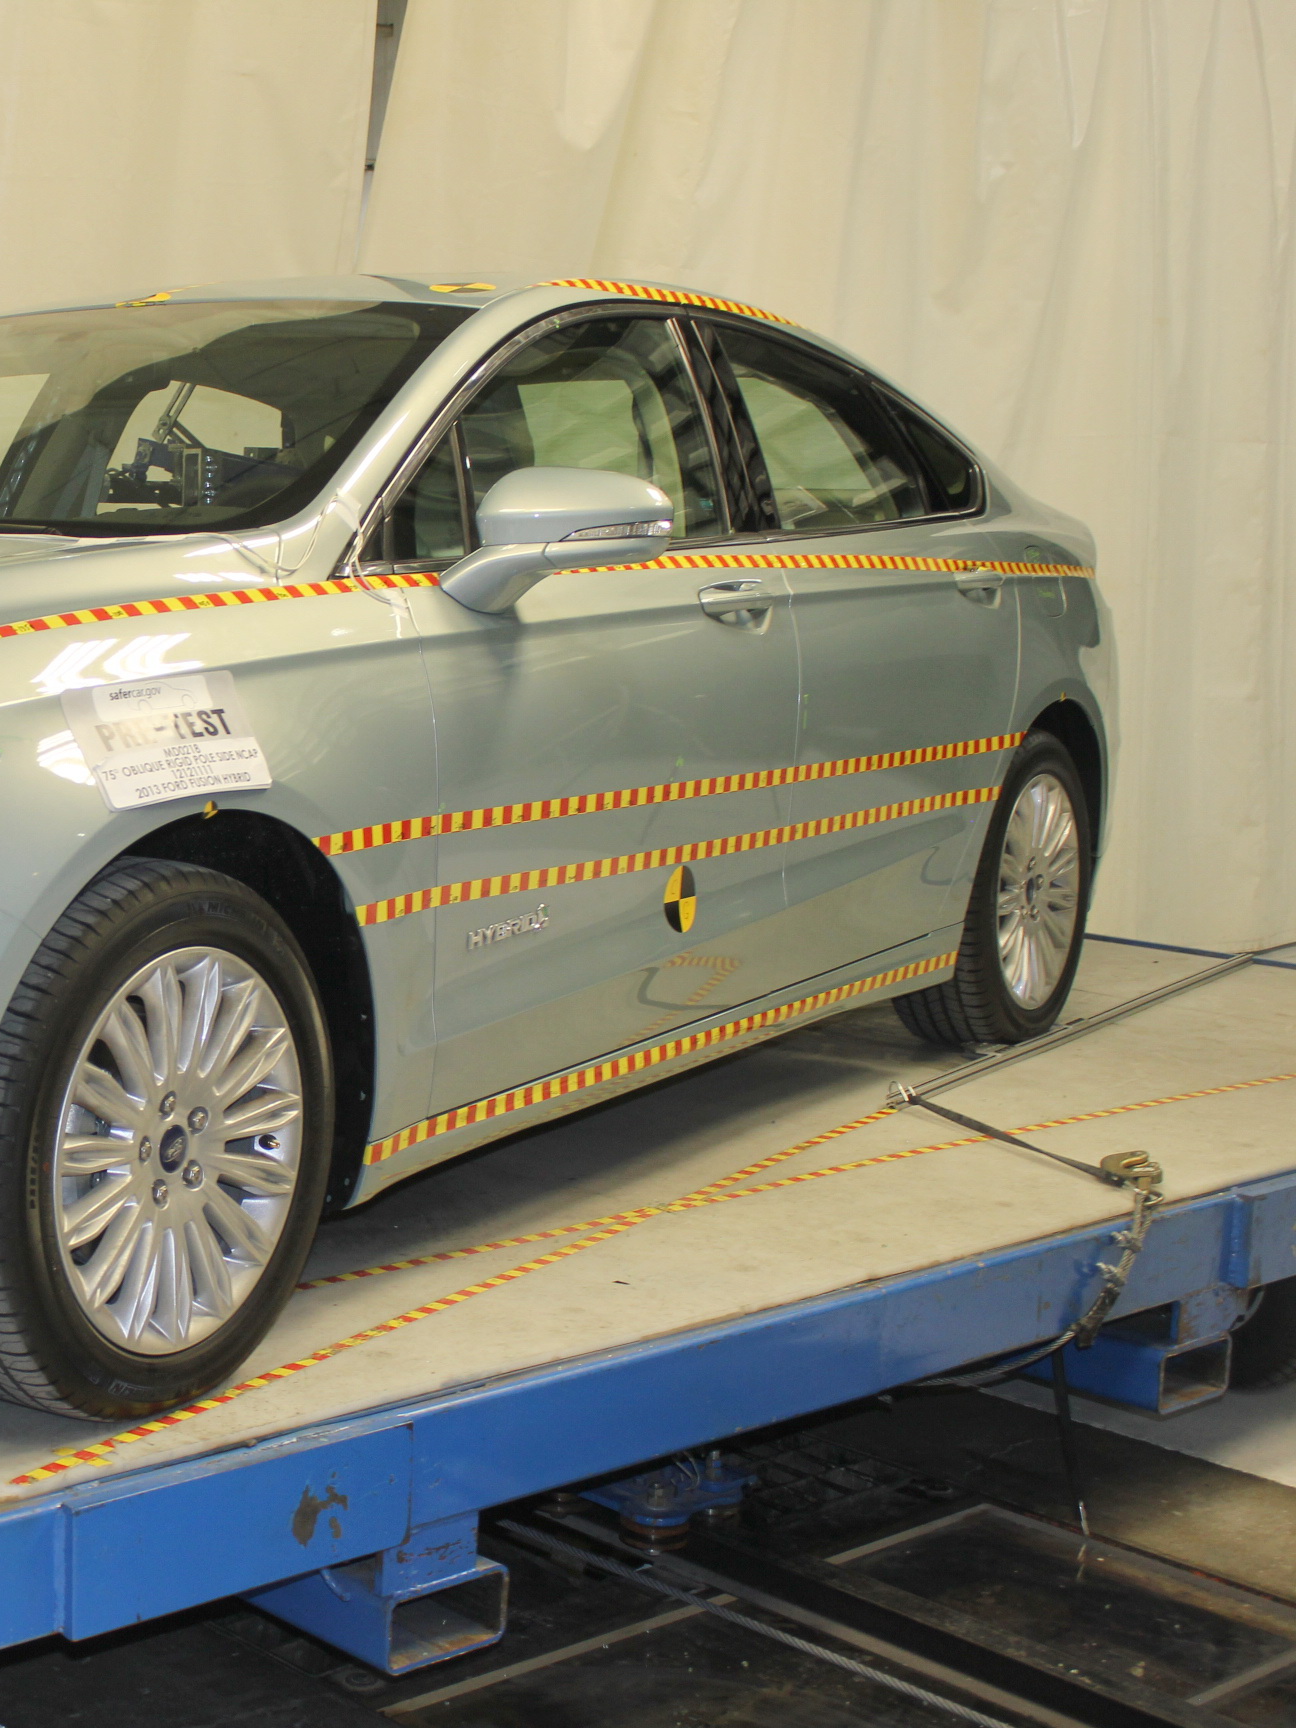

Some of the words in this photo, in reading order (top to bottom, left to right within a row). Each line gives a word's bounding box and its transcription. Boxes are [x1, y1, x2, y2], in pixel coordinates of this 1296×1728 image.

[109, 687, 162, 702] safercar.gov
[122, 761, 165, 778] OBLIQUE
[167, 757, 193, 770] RIGID
[194, 753, 217, 768] POLE
[218, 750, 235, 764] SIDE
[235, 748, 259, 762] NCAP
[135, 783, 162, 799] 2013
[162, 777, 189, 792] FORD
[190, 773, 222, 788] FUSION
[223, 771, 252, 785] HYBRID
[467, 910, 538, 951] HYBRID
